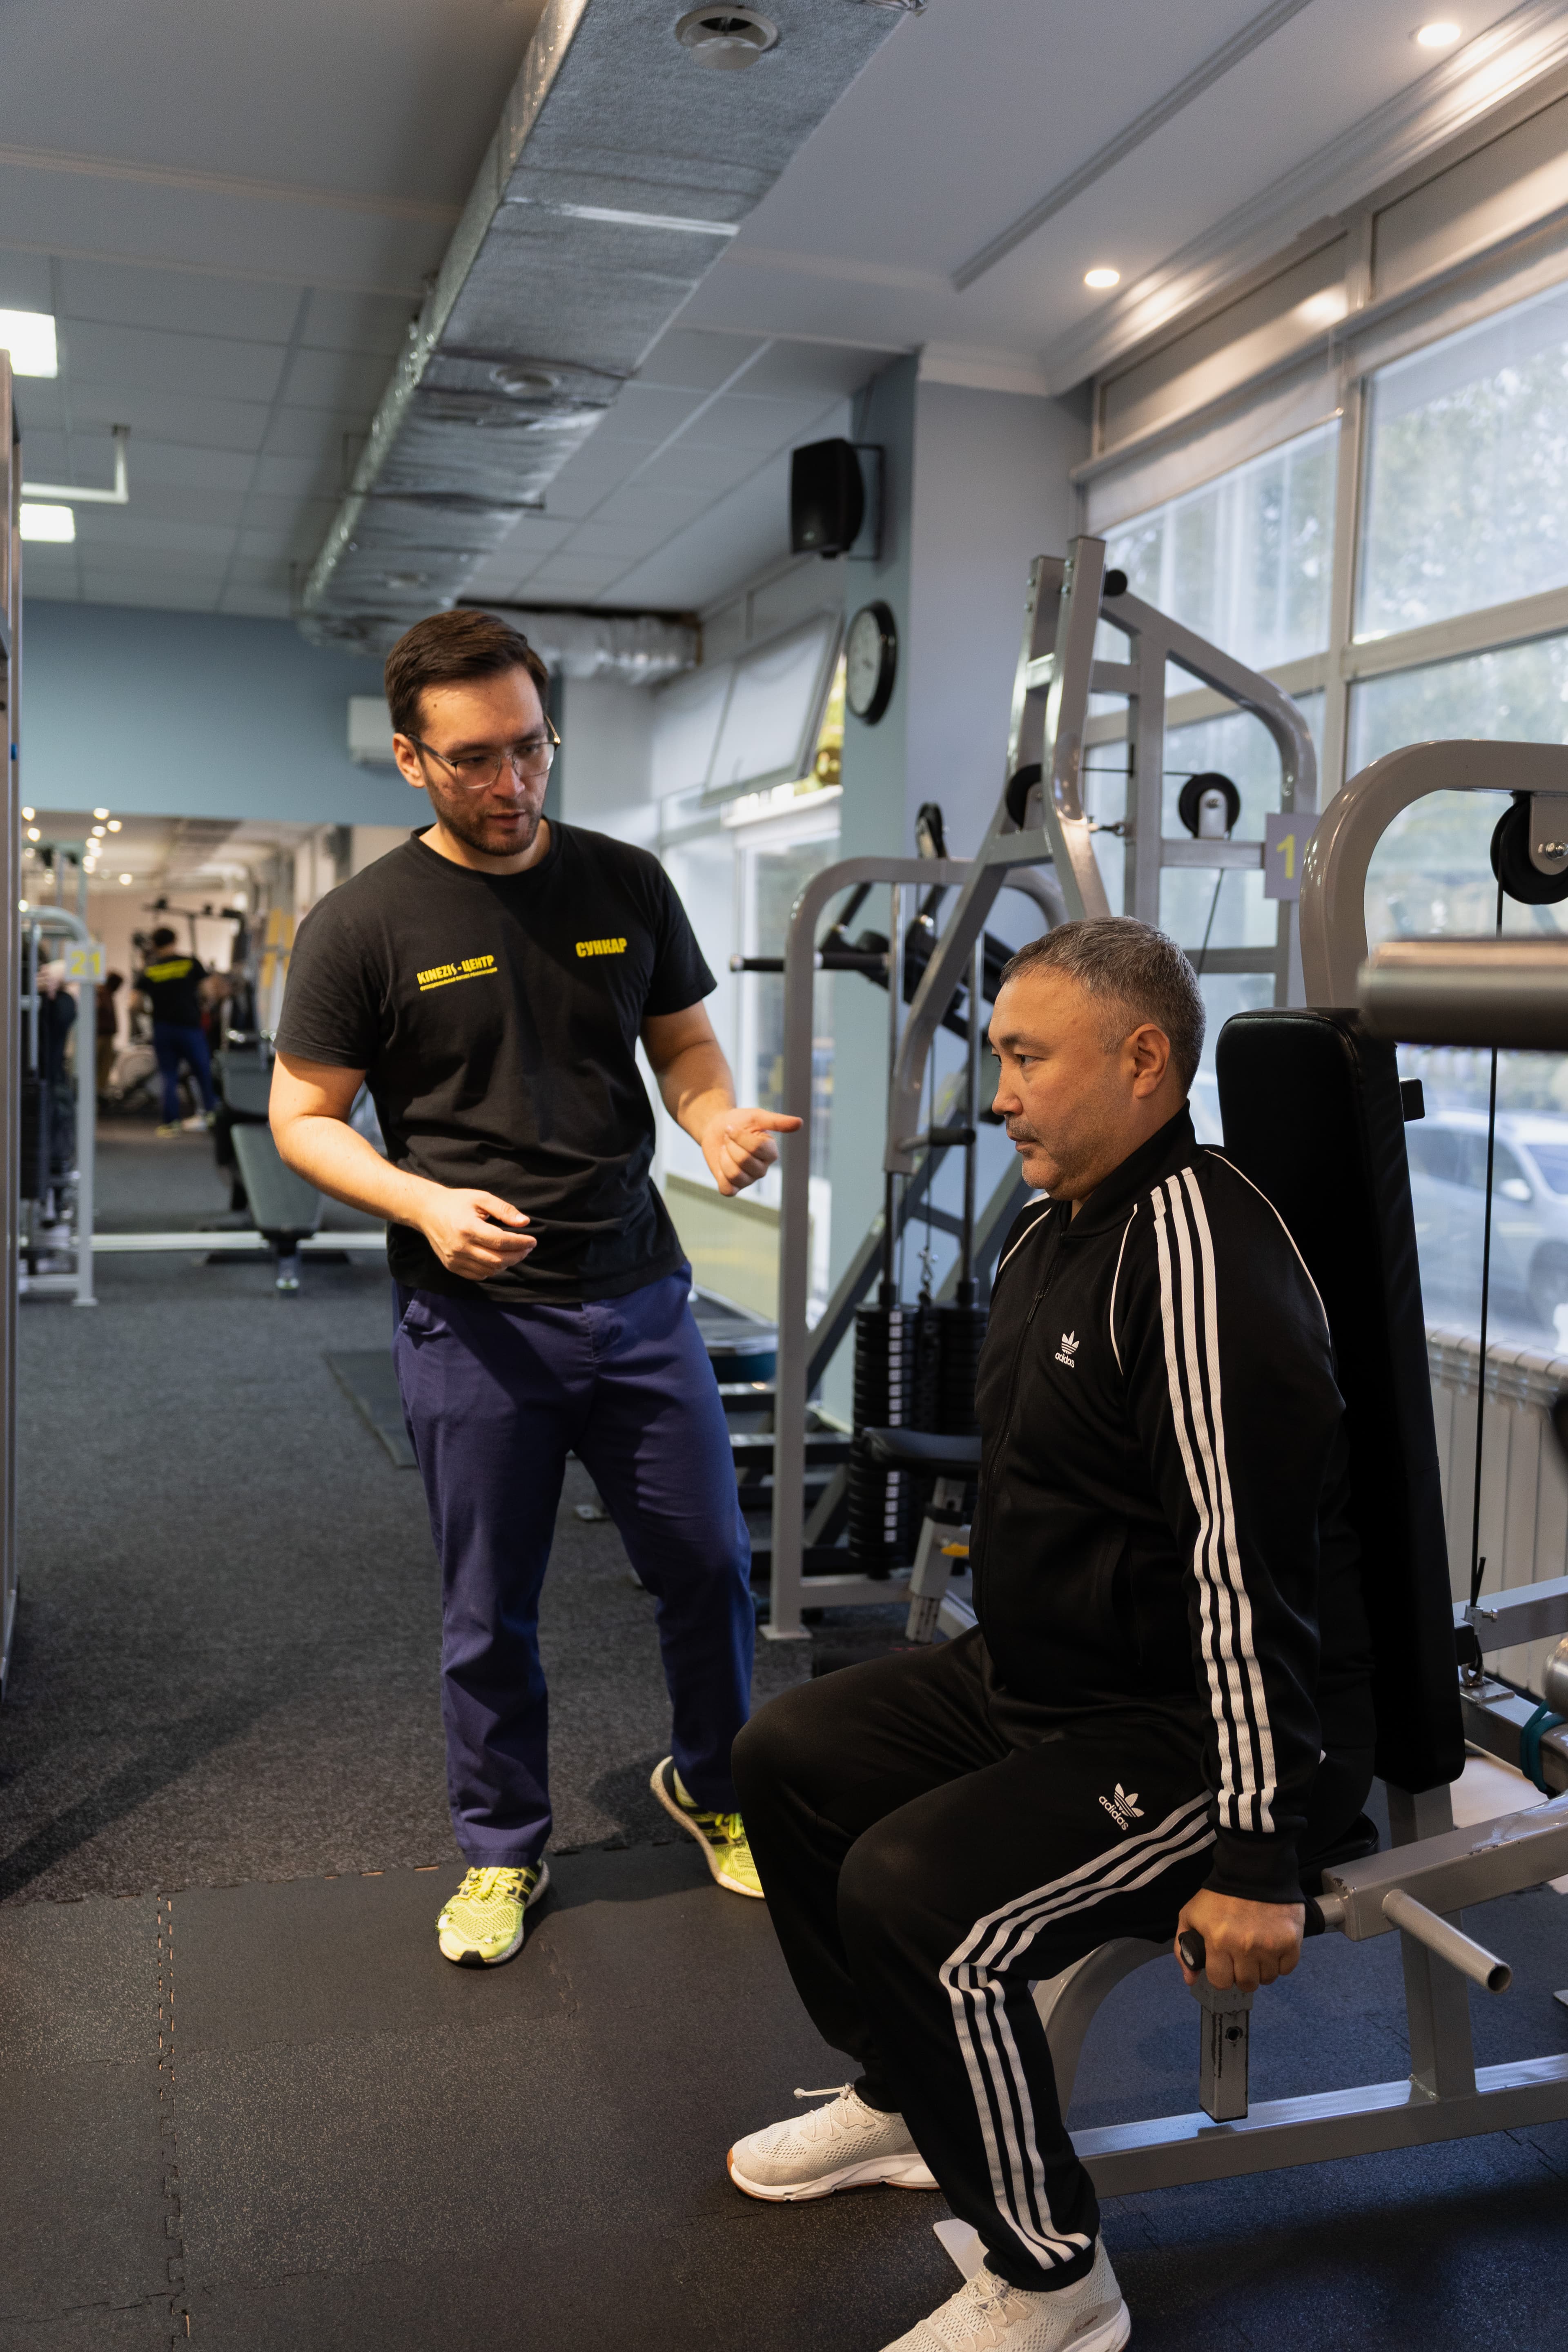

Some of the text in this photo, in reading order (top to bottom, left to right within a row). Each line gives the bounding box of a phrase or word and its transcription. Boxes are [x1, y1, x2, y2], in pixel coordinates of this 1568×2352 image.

[1276, 834, 1311, 879] 1
[575, 938, 627, 958] СУНКАР
[71, 950, 100, 976] 21
[1055, 1352, 1075, 1368] adidas
[1099, 1796, 1128, 1830] adidas
